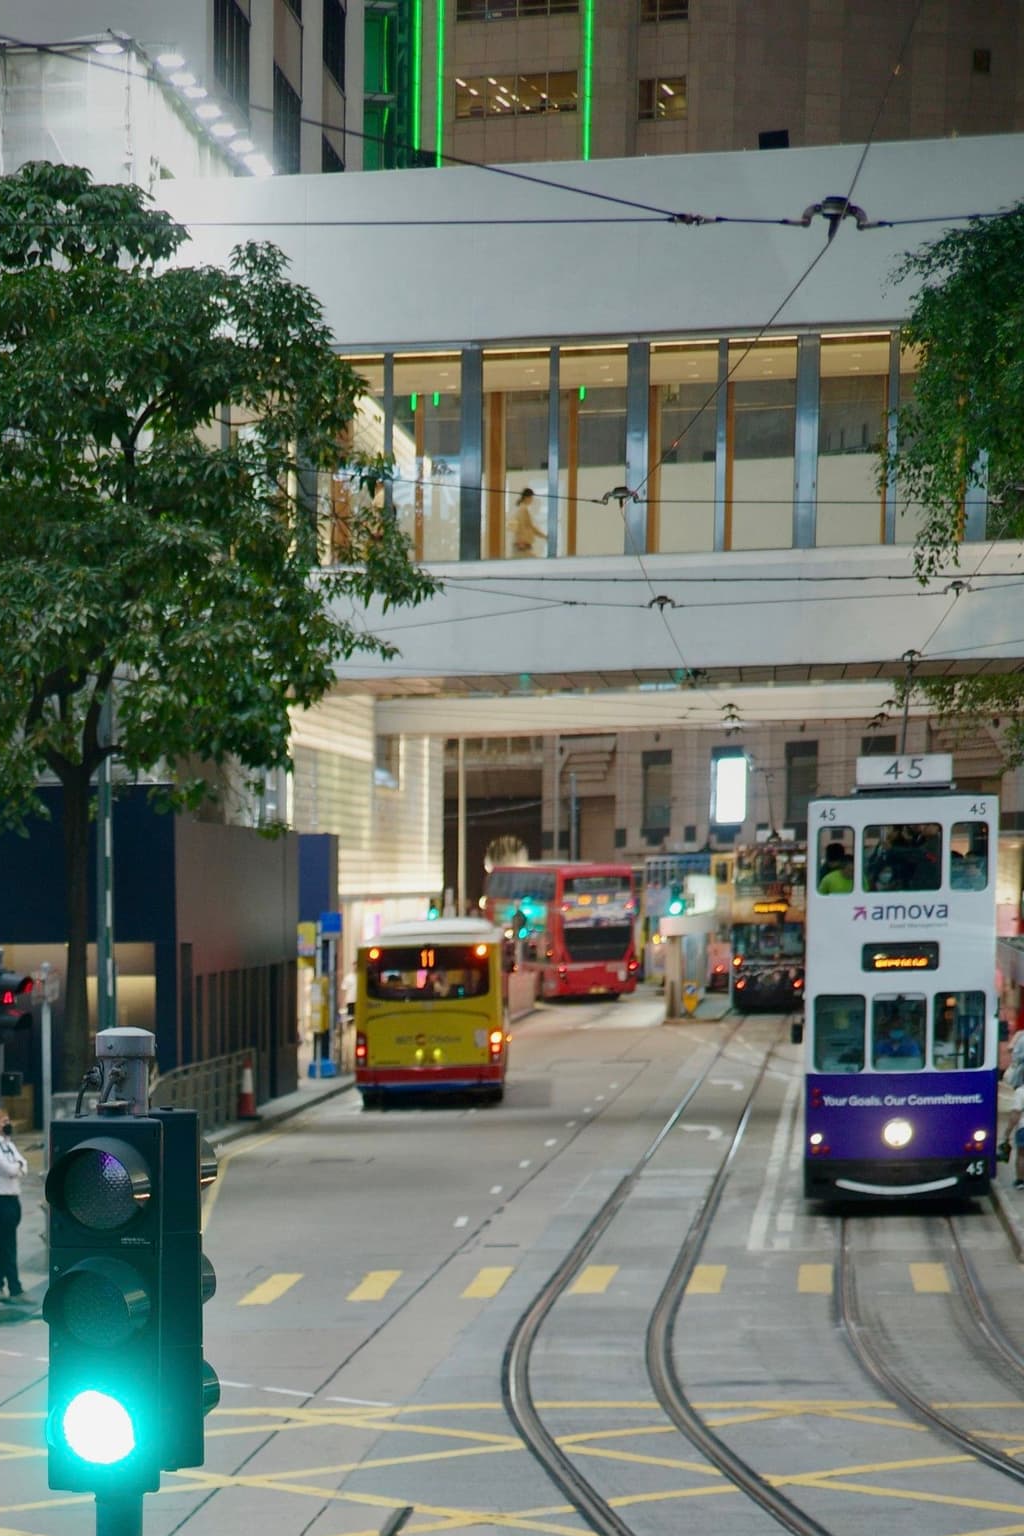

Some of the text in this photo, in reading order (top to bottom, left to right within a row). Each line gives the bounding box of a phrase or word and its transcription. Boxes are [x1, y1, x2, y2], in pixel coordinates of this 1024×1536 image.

[884, 758, 924, 780] 45
[819, 808, 837, 821] 45
[969, 803, 987, 816] 45
[871, 904, 949, 920] amova
[420, 949, 435, 968] 11
[823, 1094, 983, 1106] Your Goals. Our Commitment.
[965, 1161, 984, 1176] 45
